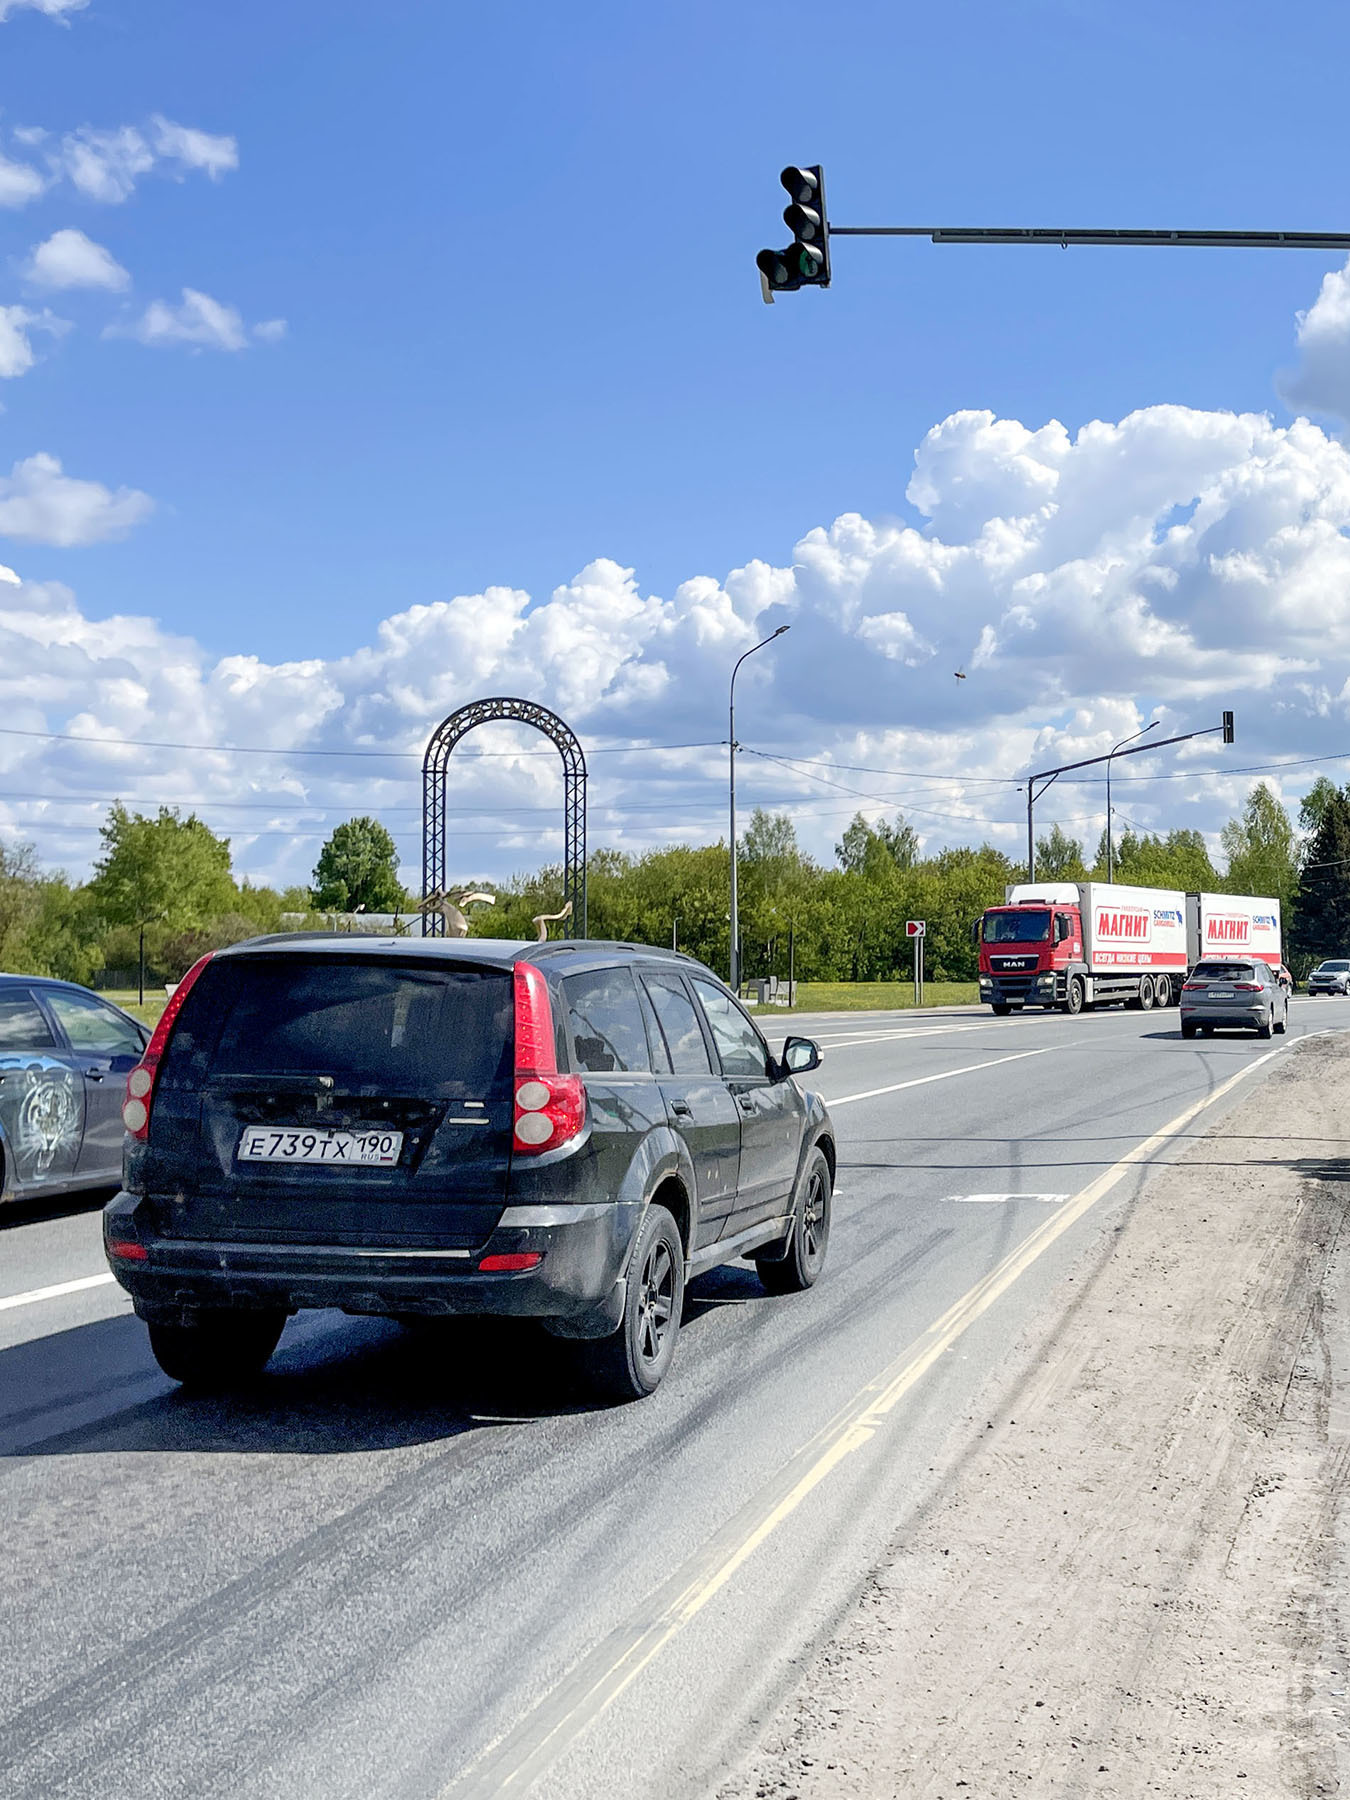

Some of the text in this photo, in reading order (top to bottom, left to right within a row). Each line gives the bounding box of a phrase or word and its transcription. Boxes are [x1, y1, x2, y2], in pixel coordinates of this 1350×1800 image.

[1098, 913, 1149, 937] МАГНИТ
[1207, 919, 1249, 940] МАГНИТ
[356, 1136, 393, 1153] 190
[360, 1153, 380, 1161] RUS
